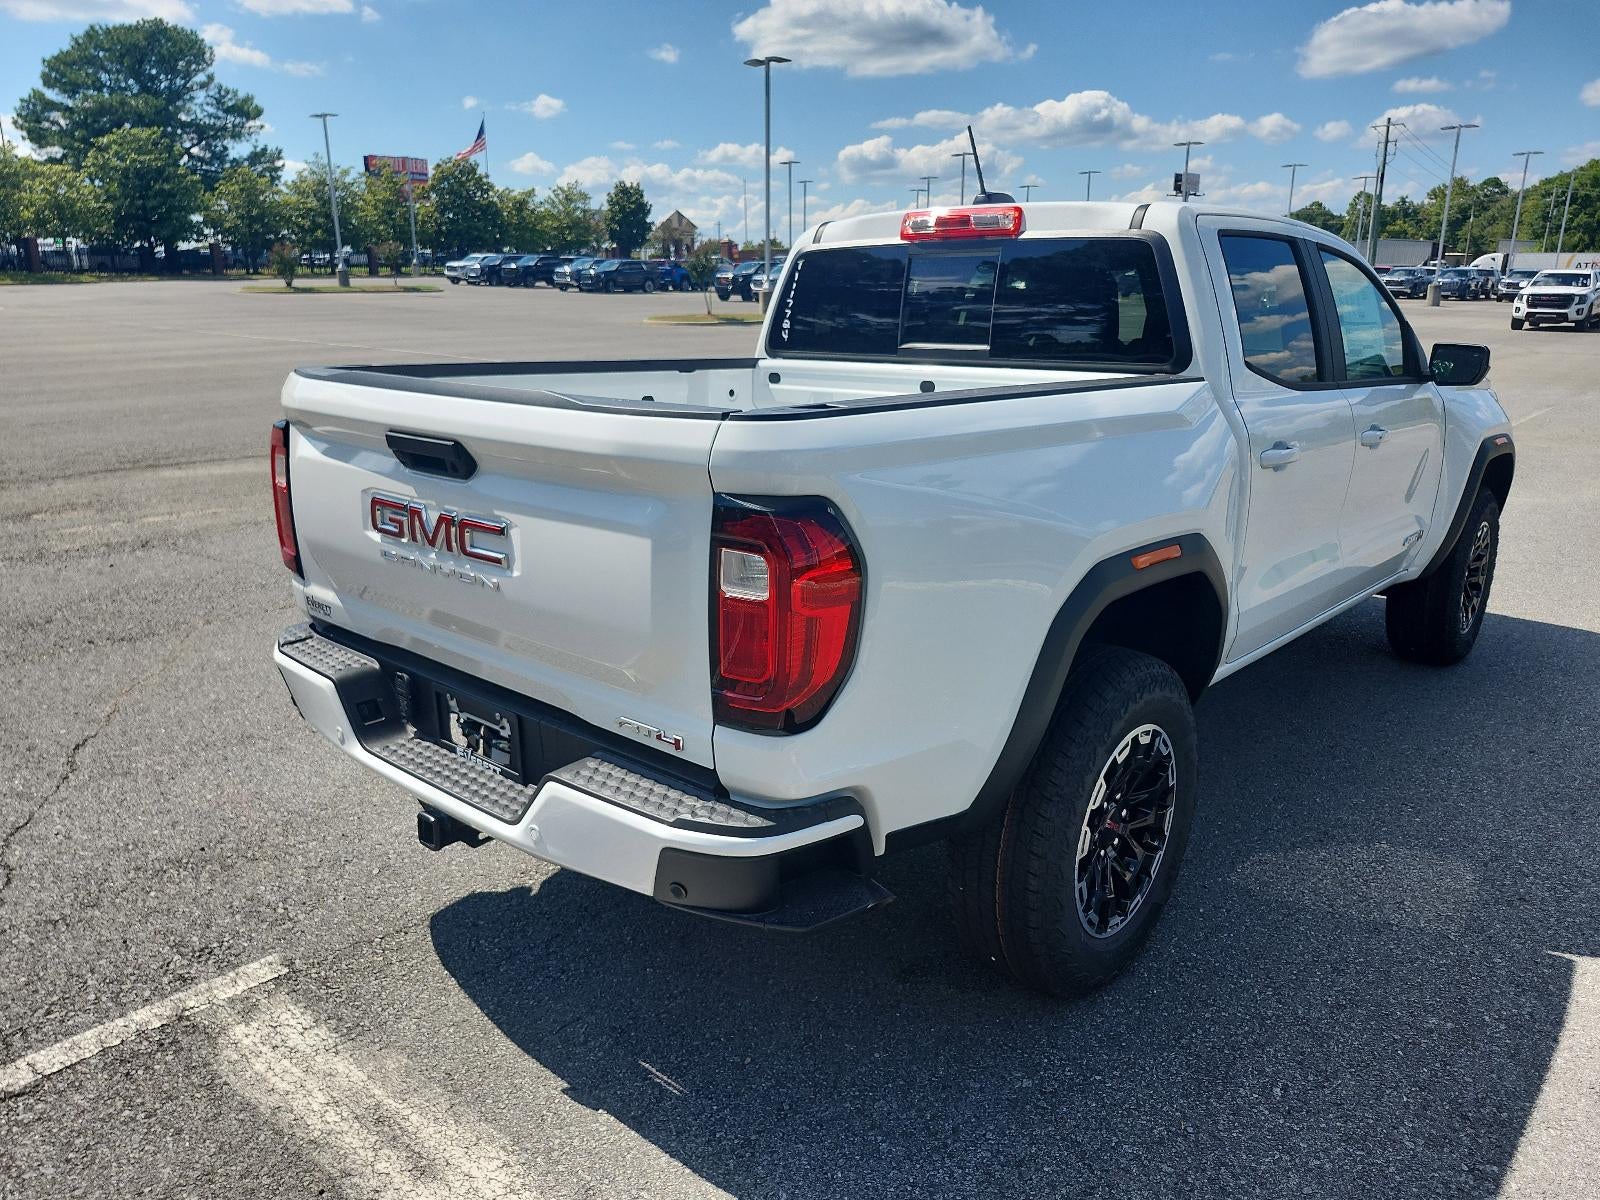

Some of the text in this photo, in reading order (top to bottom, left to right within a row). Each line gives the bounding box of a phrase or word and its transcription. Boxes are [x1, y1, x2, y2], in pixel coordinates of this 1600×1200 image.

[371, 495, 511, 569] GMC
[382, 549, 500, 592] CANYON
[617, 715, 684, 751] AT4
